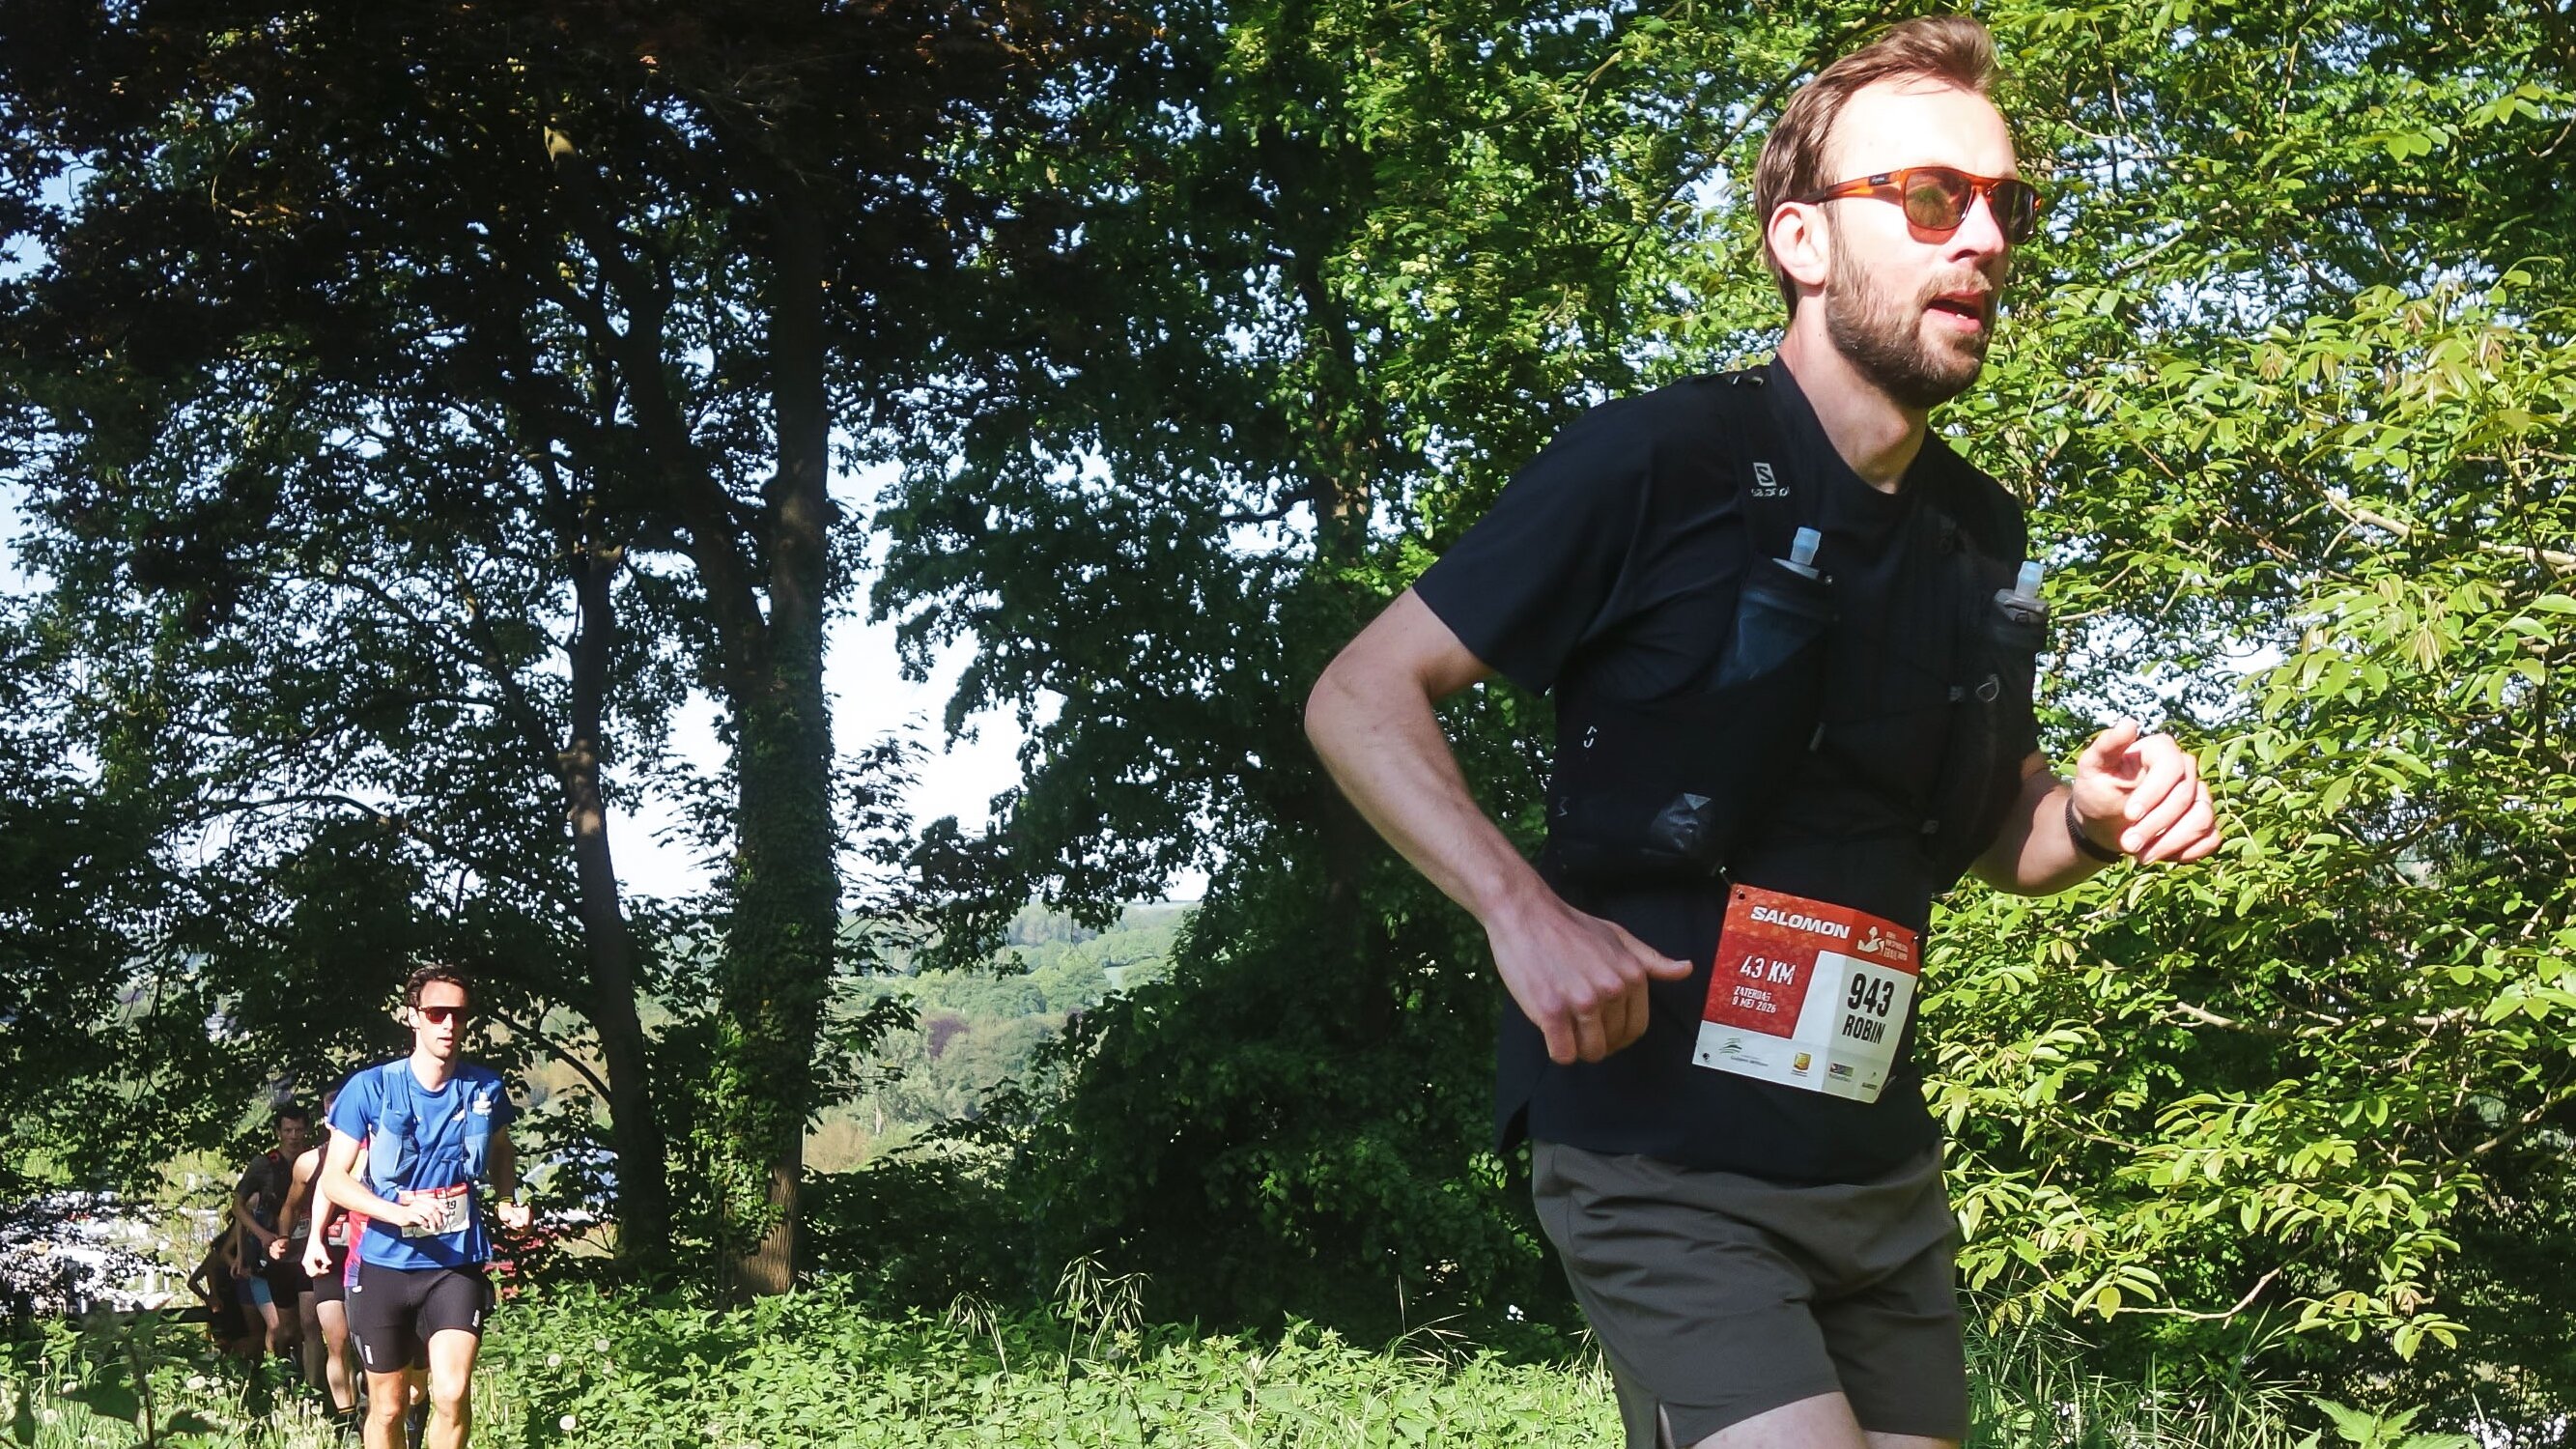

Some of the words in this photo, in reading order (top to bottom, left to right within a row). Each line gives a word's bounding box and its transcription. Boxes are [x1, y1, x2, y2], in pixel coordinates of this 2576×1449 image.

[1750, 906, 1851, 939] SALOMON
[1740, 955, 1765, 979] 43
[1767, 960, 1797, 985] KM
[1731, 995, 1740, 1006] 9
[1755, 1001, 1777, 1013] 2026
[1847, 973, 1895, 1017] 943
[1841, 1014, 1886, 1044] ROBIN
